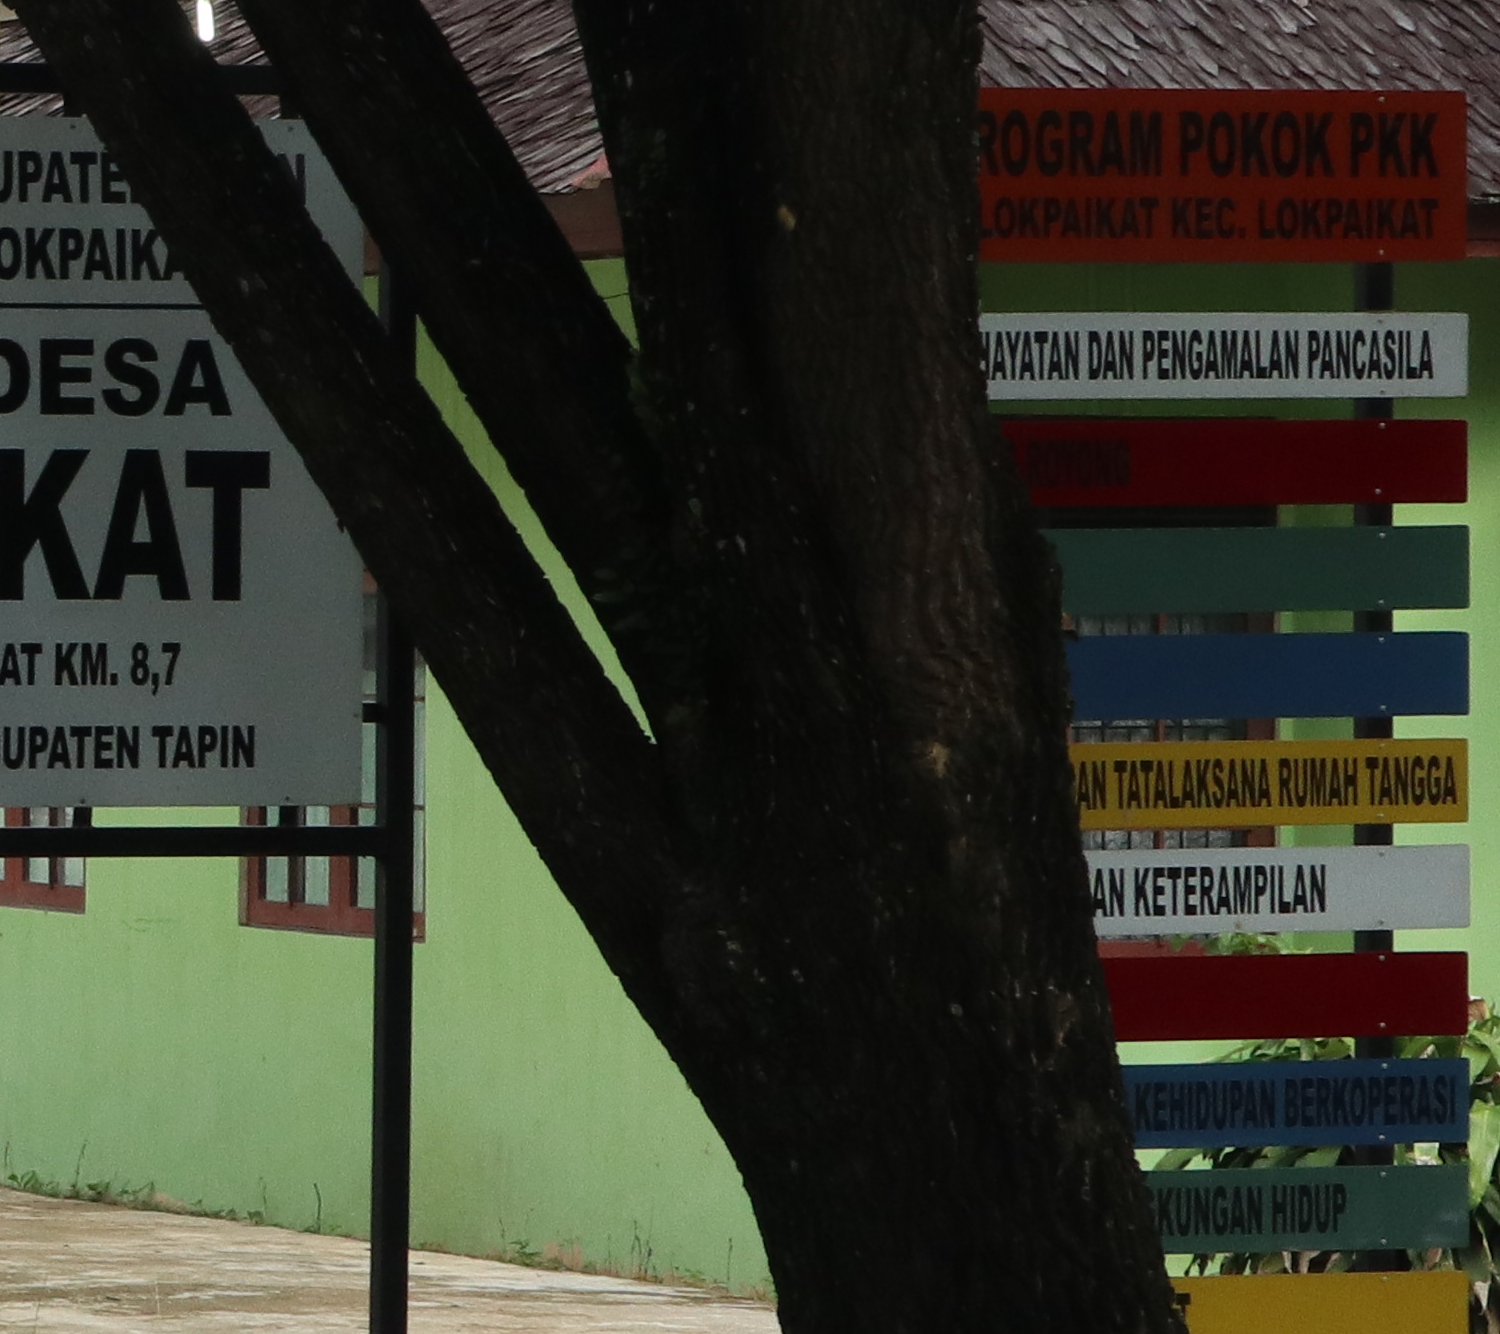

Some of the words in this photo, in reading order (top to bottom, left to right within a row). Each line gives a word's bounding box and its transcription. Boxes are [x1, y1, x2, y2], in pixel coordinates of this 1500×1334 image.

[979, 111, 1161, 176] ROGRAM
[1180, 111, 1335, 177] POKOK
[1350, 112, 1439, 178] PKK
[1171, 198, 1245, 238] KEC.
[1258, 198, 1439, 239] LOKPAIKAT
[979, 330, 1080, 380] HAYATAN
[1088, 331, 1133, 380] DAN
[1142, 330, 1299, 380] PENGAMALAN
[1308, 330, 1433, 380] PANCASILA
[55, 643, 118, 685] KM.
[130, 642, 181, 696] 8,7
[152, 726, 255, 768] TAPIN
[1078, 759, 1106, 811] AN
[1114, 758, 1271, 810] TATALAKSANA
[1279, 758, 1357, 808] RUMAH
[1366, 756, 1457, 806] TANGGA
[1094, 869, 1124, 917] AN
[1134, 864, 1325, 916] KETERAMPILAN
[1134, 1079, 1276, 1133] KEHIDUPAN
[1285, 1075, 1456, 1127] BERKOPERASI
[1158, 1185, 1263, 1236] KUNGAN
[1271, 1183, 1347, 1233] HIDUP
